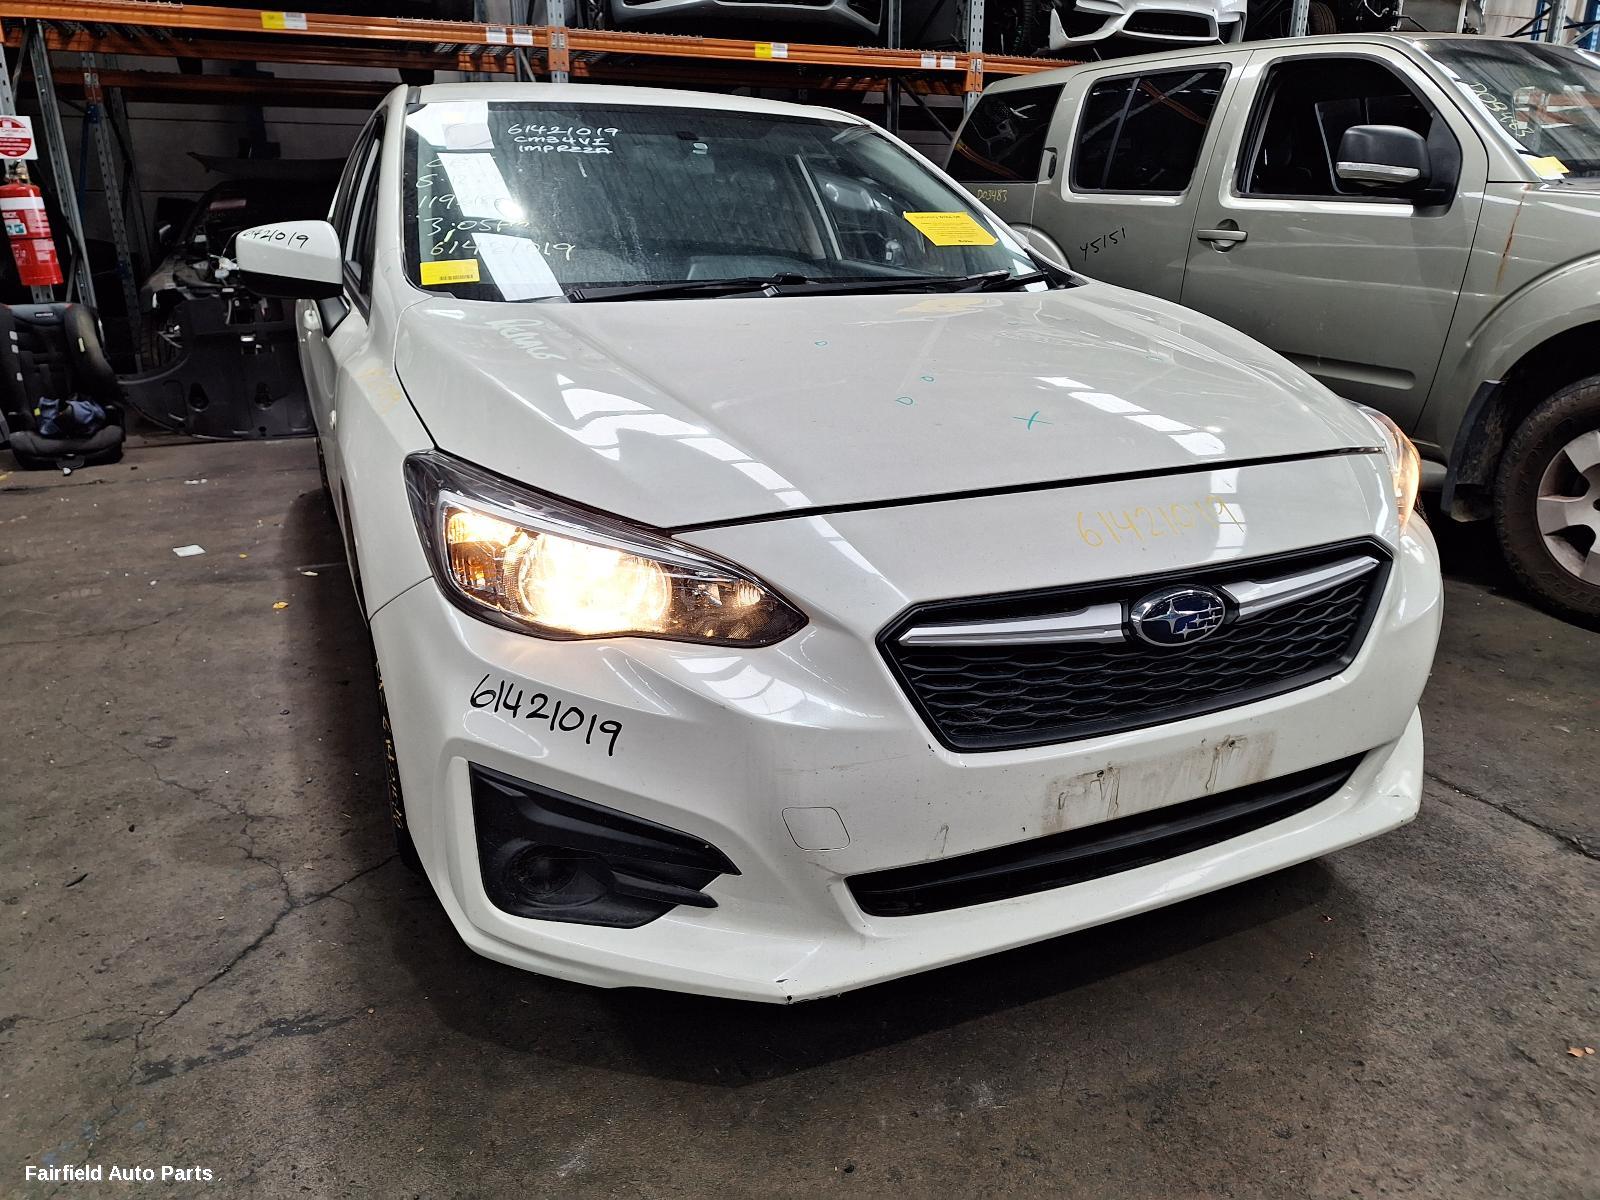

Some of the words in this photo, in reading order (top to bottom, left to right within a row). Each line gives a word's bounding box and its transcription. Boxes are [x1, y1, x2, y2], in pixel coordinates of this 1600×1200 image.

[508, 124, 619, 137] 61421019
[1077, 495, 1246, 548] 61421019
[470, 674, 623, 757] 61421019
